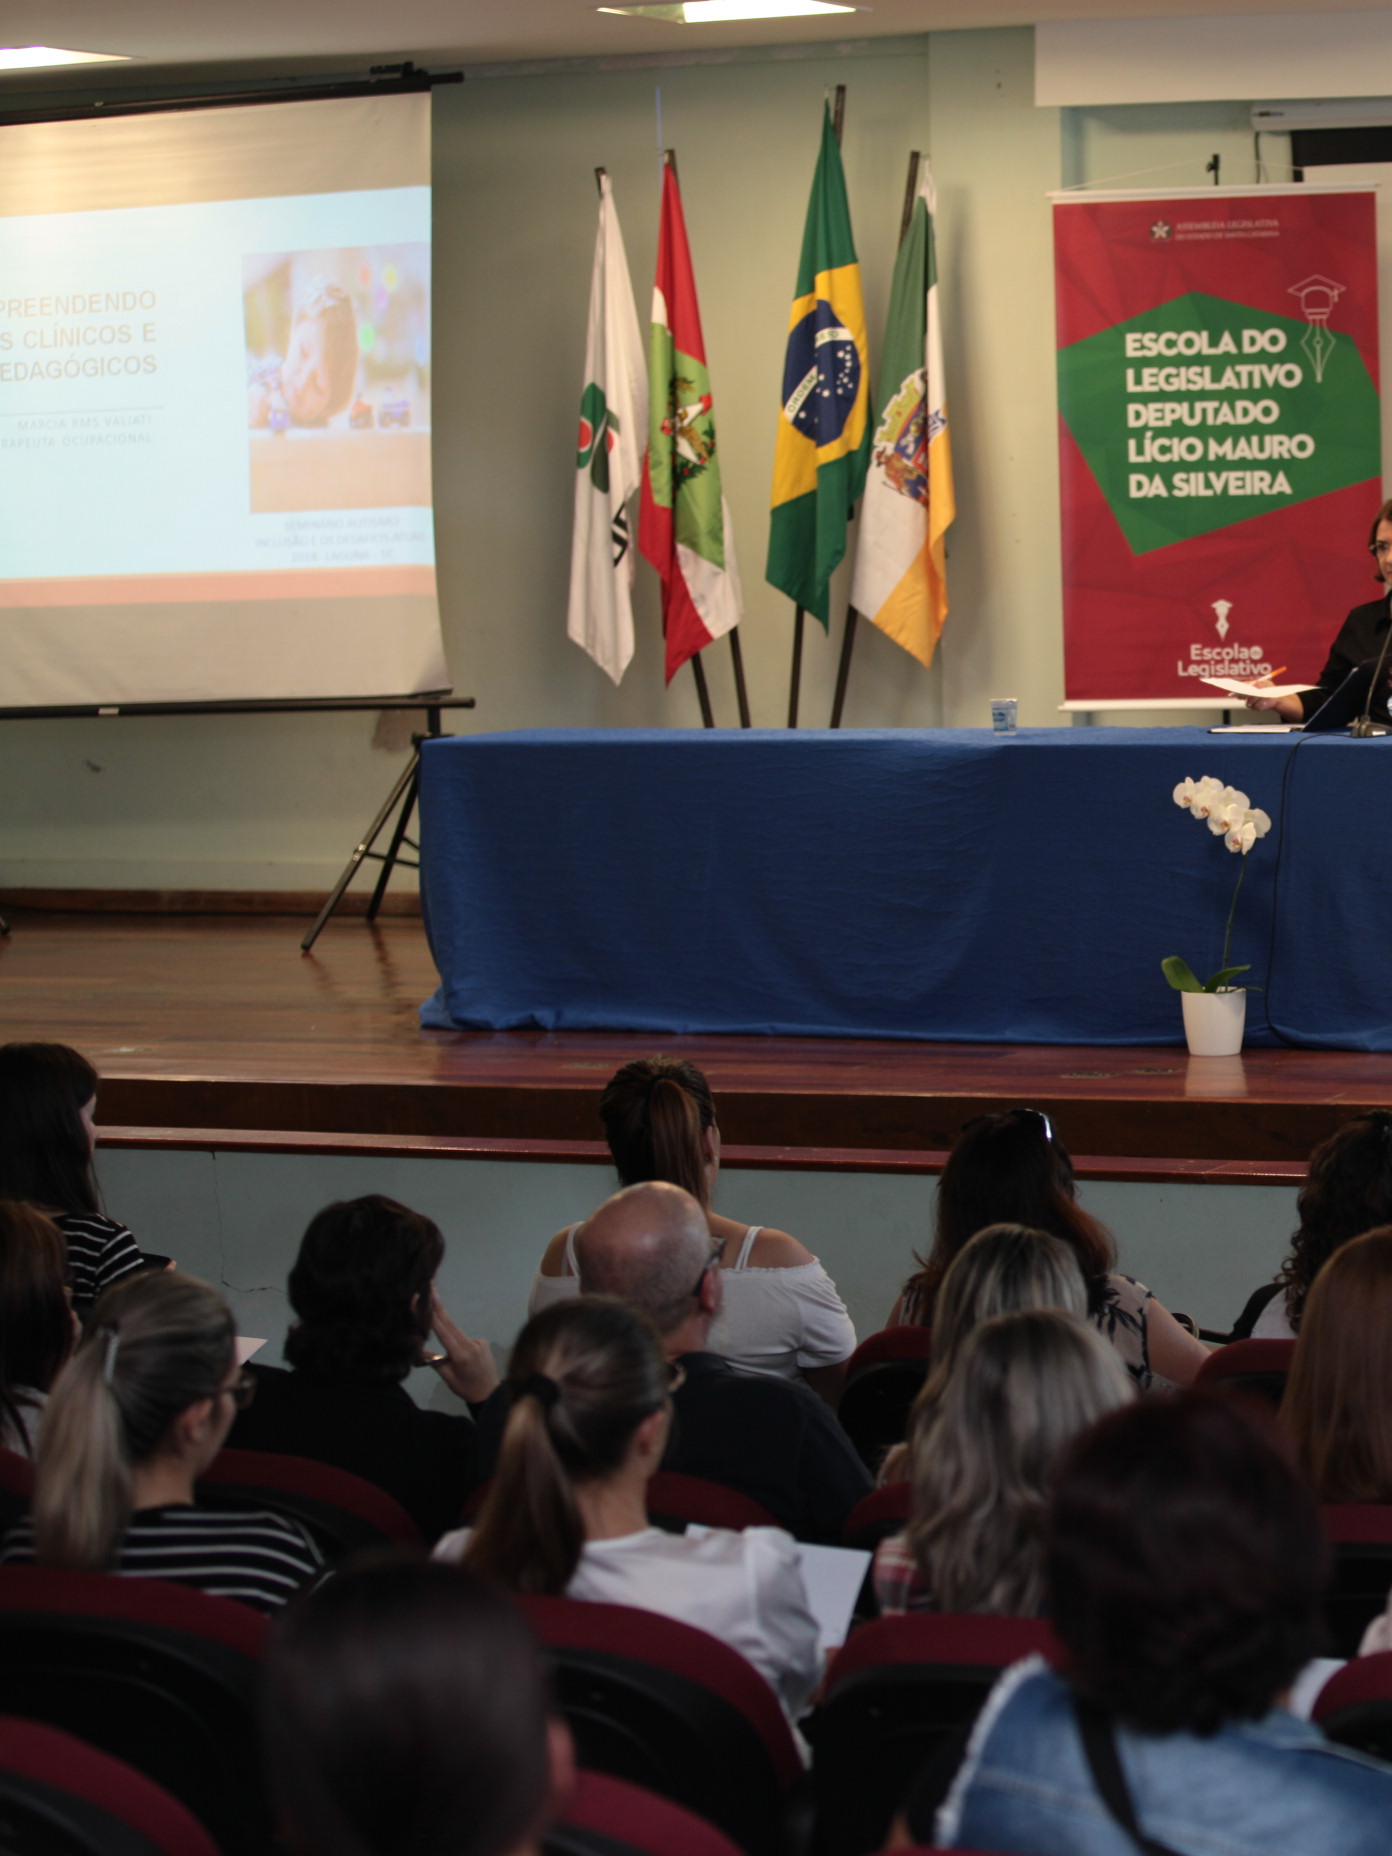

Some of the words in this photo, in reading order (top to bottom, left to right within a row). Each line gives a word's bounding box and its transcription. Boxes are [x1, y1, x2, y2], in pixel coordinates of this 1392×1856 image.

[23, 322, 133, 350] CLÍNICOS
[142, 321, 157, 343] E
[1125, 330, 1238, 358] ESCOLA
[1242, 328, 1287, 355] DO
[0, 353, 158, 382] EDAGÓGICOS
[1126, 363, 1303, 393] LEGISLATIVO
[1127, 399, 1280, 428] DEPUTADO
[62, 432, 154, 448] OCUPACIONAL
[1128, 430, 1204, 463] LÍCIO
[1208, 433, 1315, 461] MAURO
[1129, 473, 1169, 498] DA
[1172, 469, 1293, 497] SILVEIRA
[1190, 642, 1249, 660] Escola
[1177, 660, 1272, 679] Legislativo
